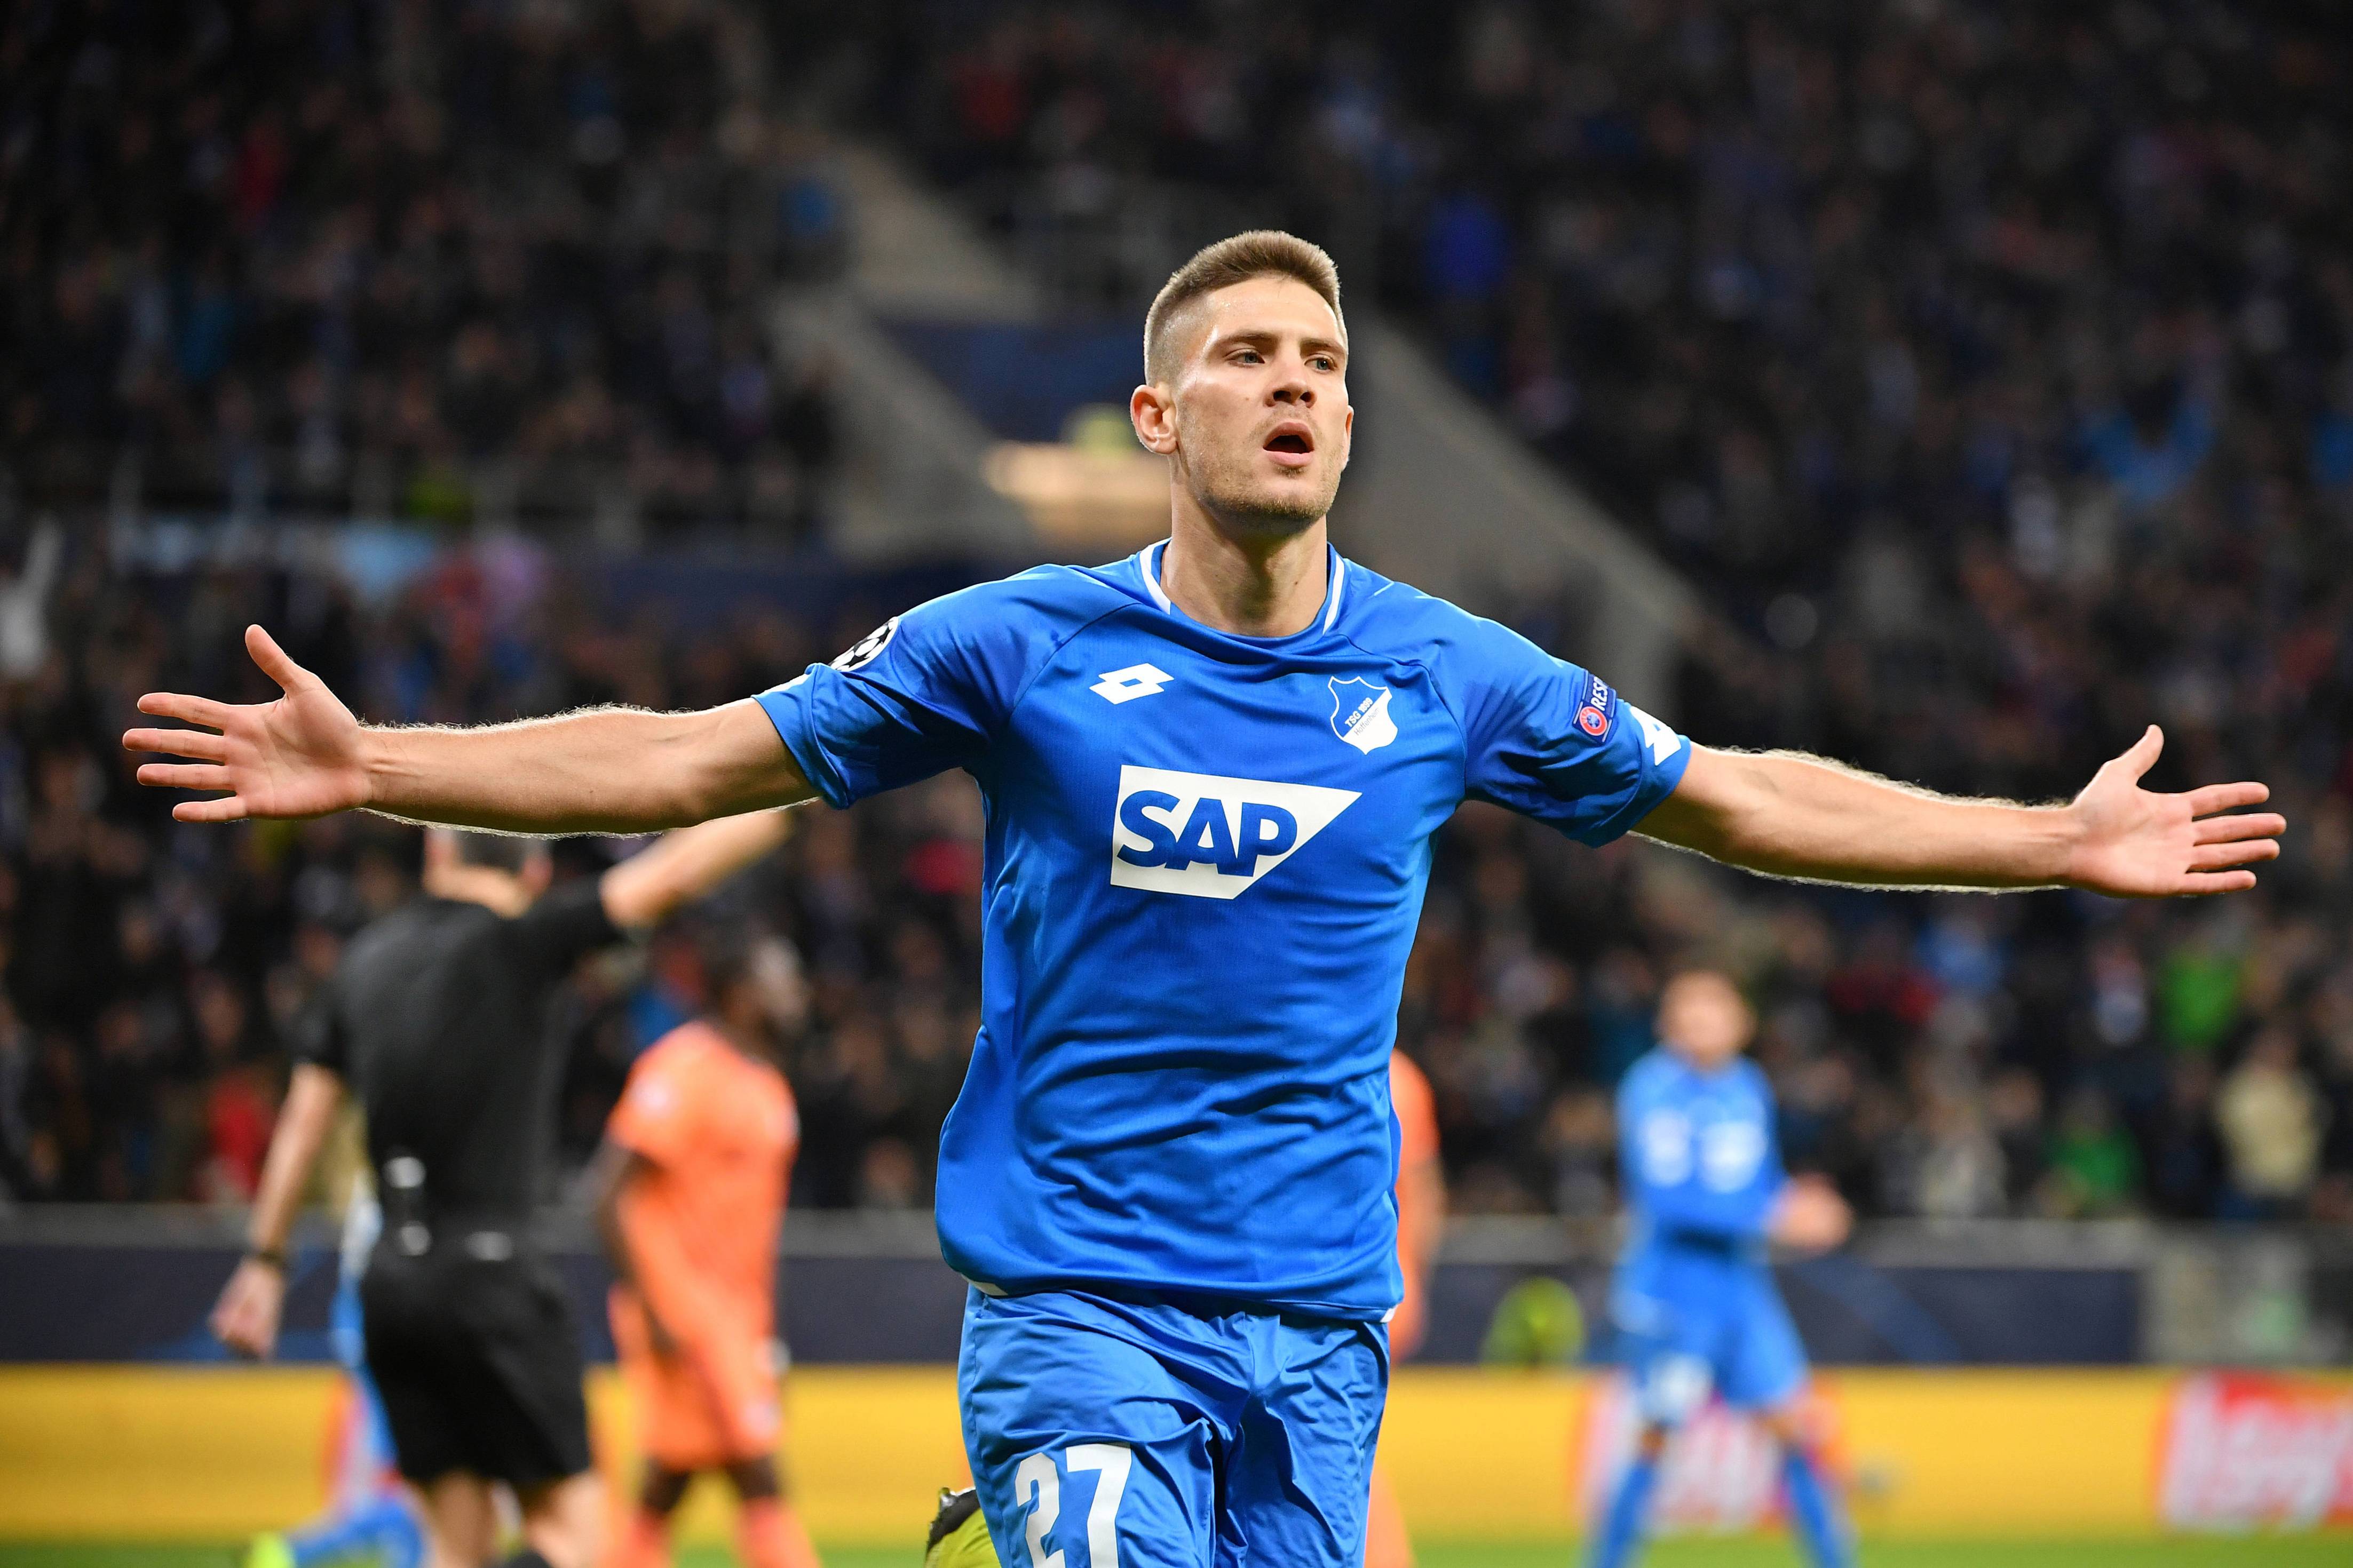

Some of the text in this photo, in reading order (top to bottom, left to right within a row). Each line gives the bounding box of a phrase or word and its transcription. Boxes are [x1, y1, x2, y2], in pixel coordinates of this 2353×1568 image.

[1344, 697, 1373, 727] TSG 1899
[1116, 790, 1297, 878] SAP
[1015, 1442, 1132, 1568] 27
